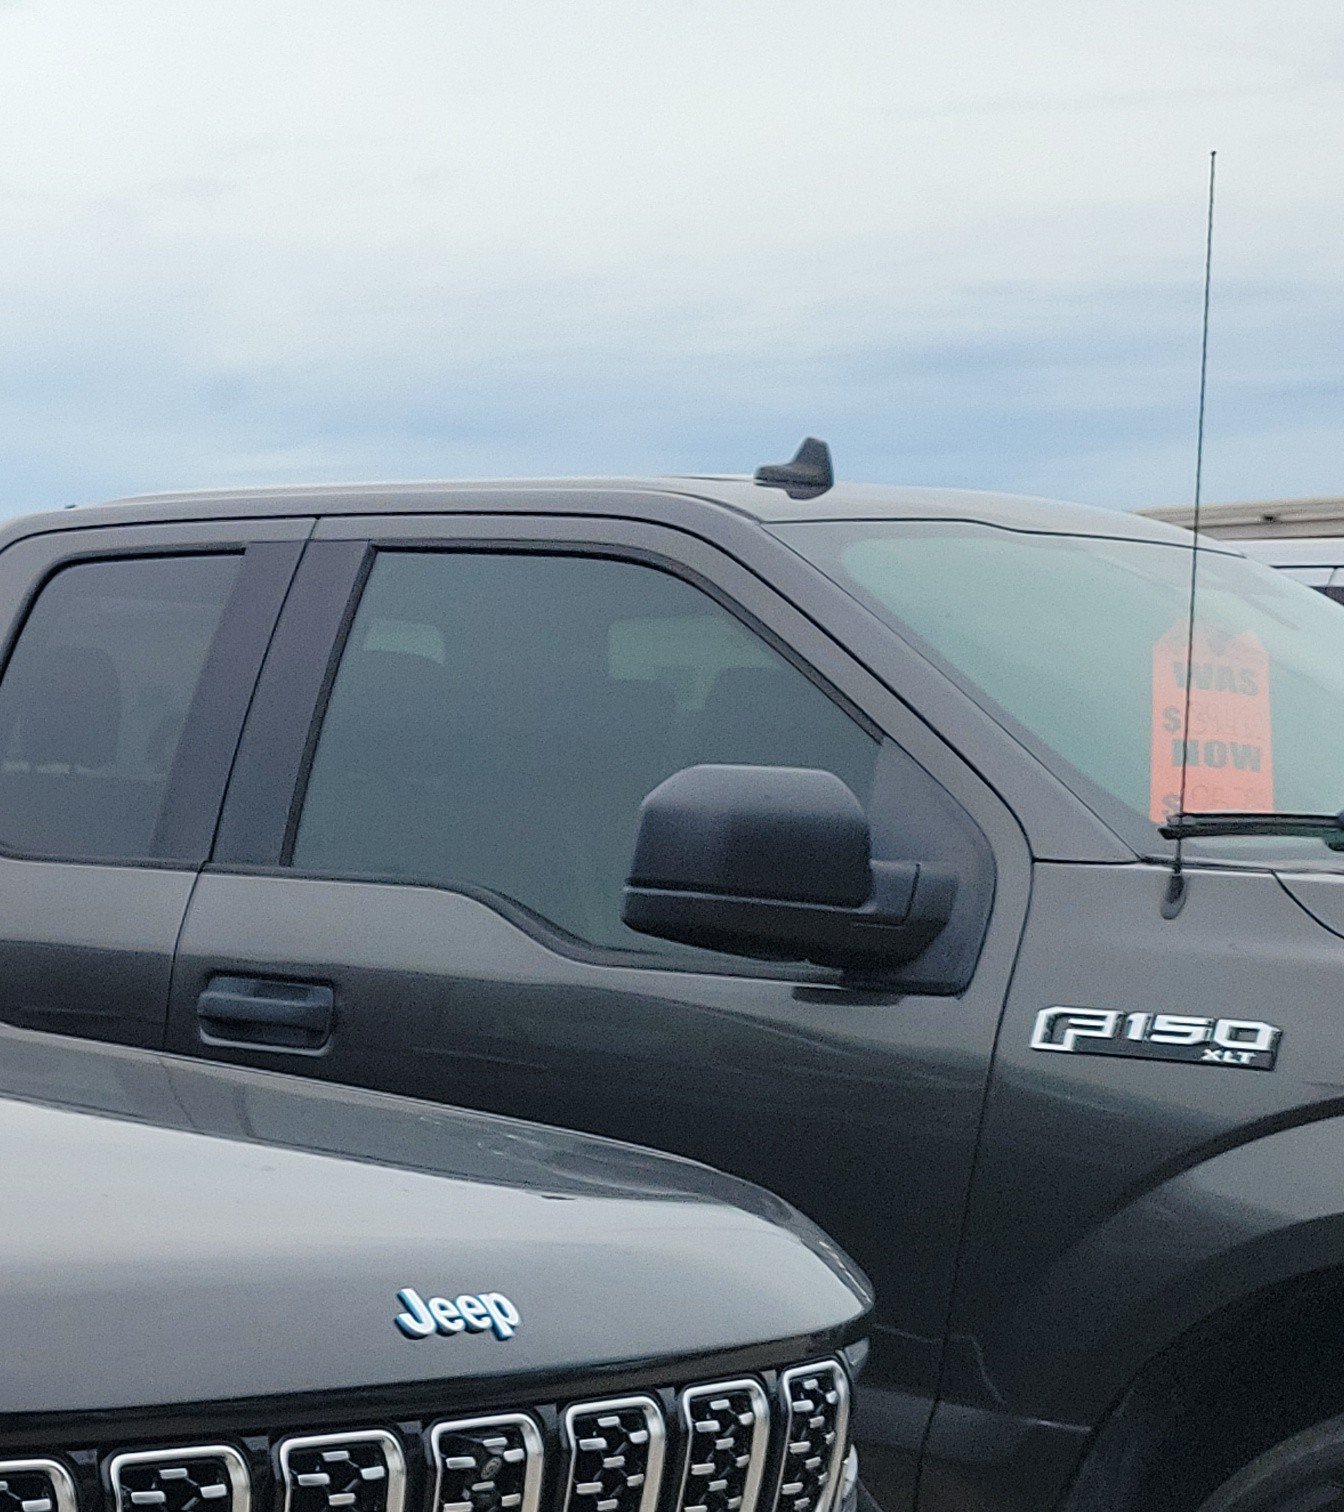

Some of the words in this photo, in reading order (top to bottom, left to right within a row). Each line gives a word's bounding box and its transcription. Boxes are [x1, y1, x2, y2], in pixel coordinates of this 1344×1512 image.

[1173, 661, 1258, 696] WAS
[1171, 739, 1261, 773] NOW
[1200, 1048, 1256, 1065] XLT
[395, 1287, 521, 1340] Jeep
